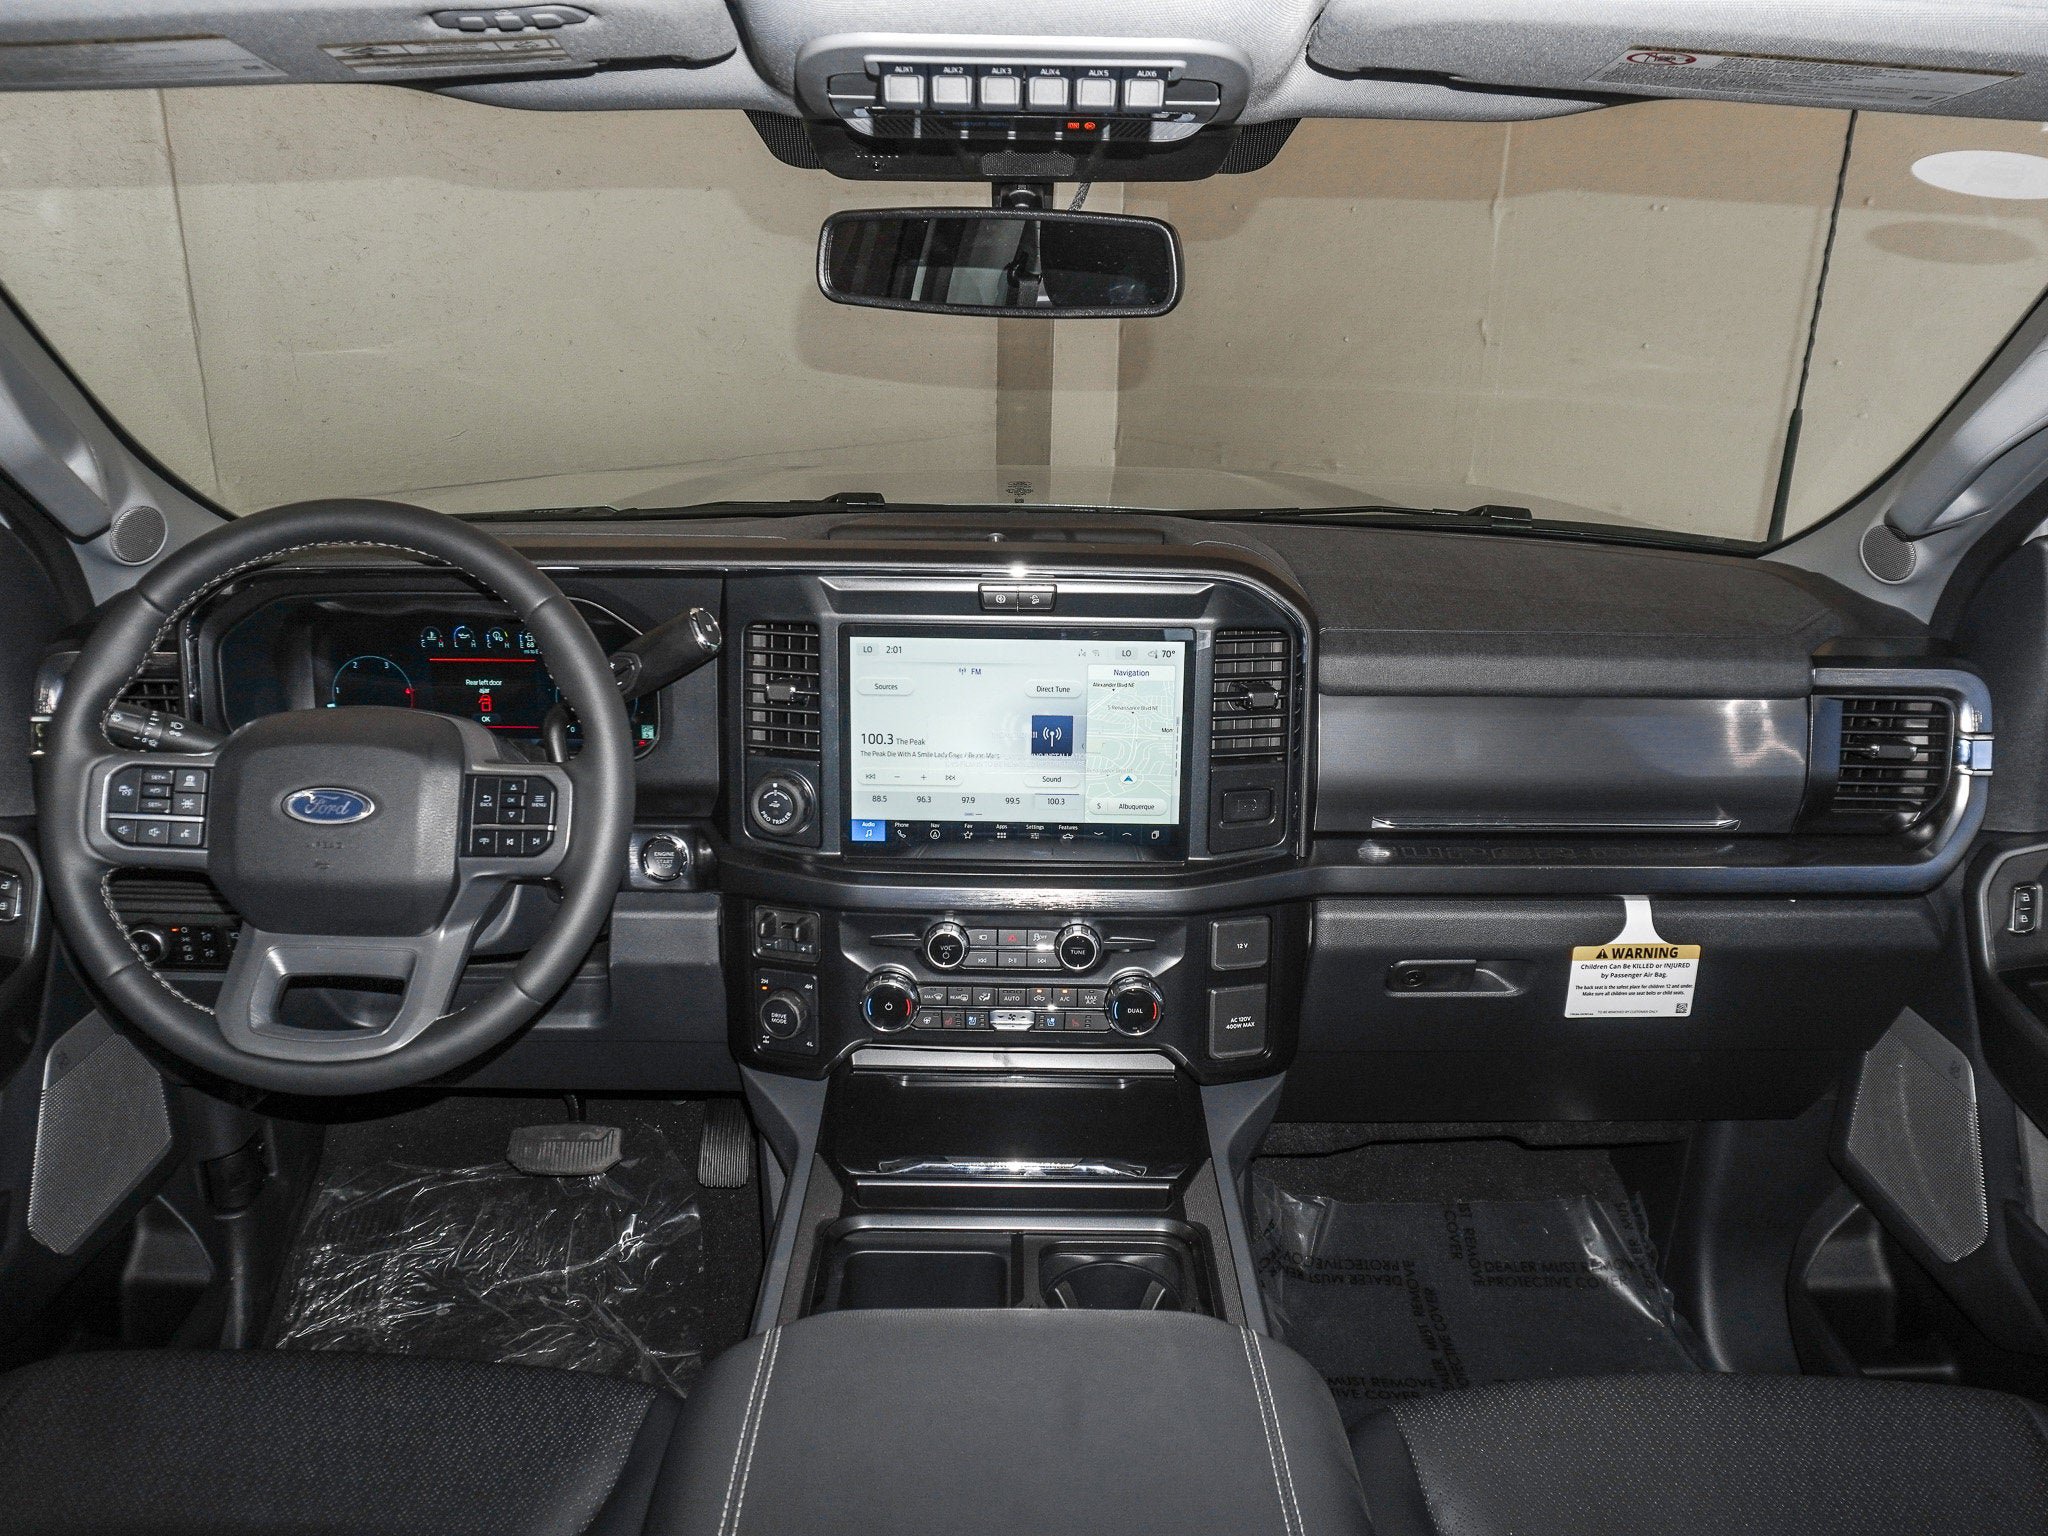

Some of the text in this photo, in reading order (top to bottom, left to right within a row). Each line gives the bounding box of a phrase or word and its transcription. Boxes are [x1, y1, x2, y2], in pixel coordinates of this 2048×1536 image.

[886, 645, 902, 654] 2:01
[353, 661, 358, 669] 2
[384, 661, 389, 669] 3
[1113, 669, 1150, 677] Navigation
[861, 733, 894, 745] 100.3
[909, 738, 925, 746] Peak
[304, 794, 351, 814] Ford
[872, 795, 888, 803] 88.5
[1005, 797, 1021, 805] 99.5
[1612, 947, 1679, 959] WARNING
[1484, 1261, 1579, 1273] DEALER MUST
[1487, 1276, 1573, 1289] PROTECTIVE
